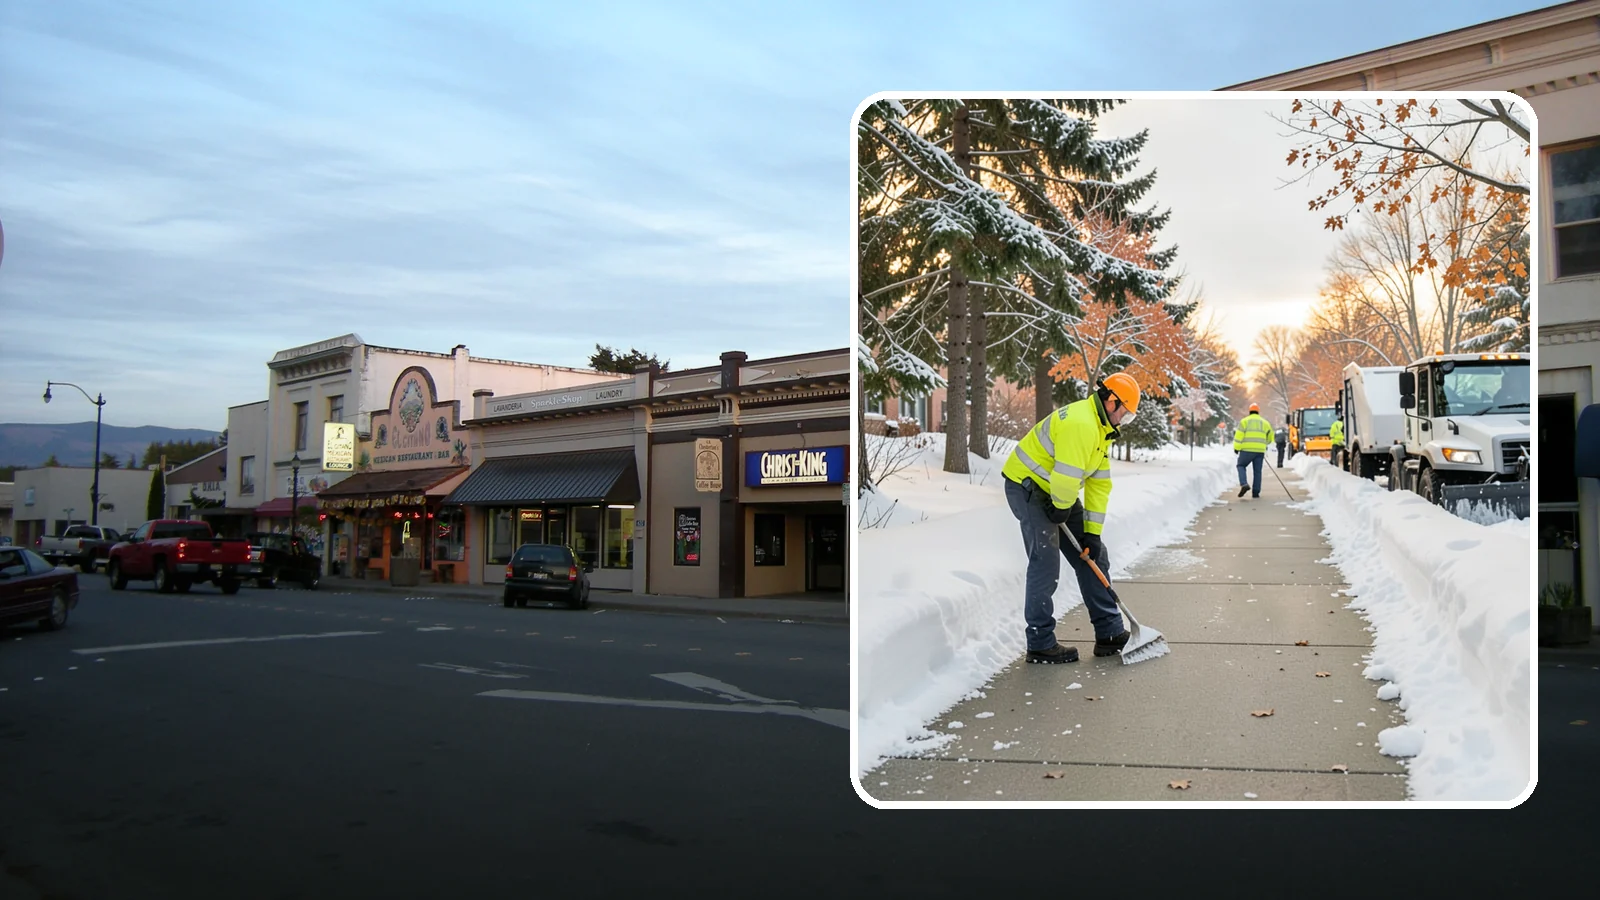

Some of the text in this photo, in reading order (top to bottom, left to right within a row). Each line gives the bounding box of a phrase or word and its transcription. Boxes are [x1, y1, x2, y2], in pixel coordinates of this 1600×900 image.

[561, 394, 582, 405] Shop
[595, 389, 623, 400] LAUNDRY
[493, 402, 522, 412] LAVANDERIA
[373, 454, 396, 464] MEXICAN
[397, 451, 434, 462] RESTAURANT
[438, 450, 450, 458] BAR
[760, 449, 827, 478] CHRIST KING
[696, 480, 722, 489] Coffee House
